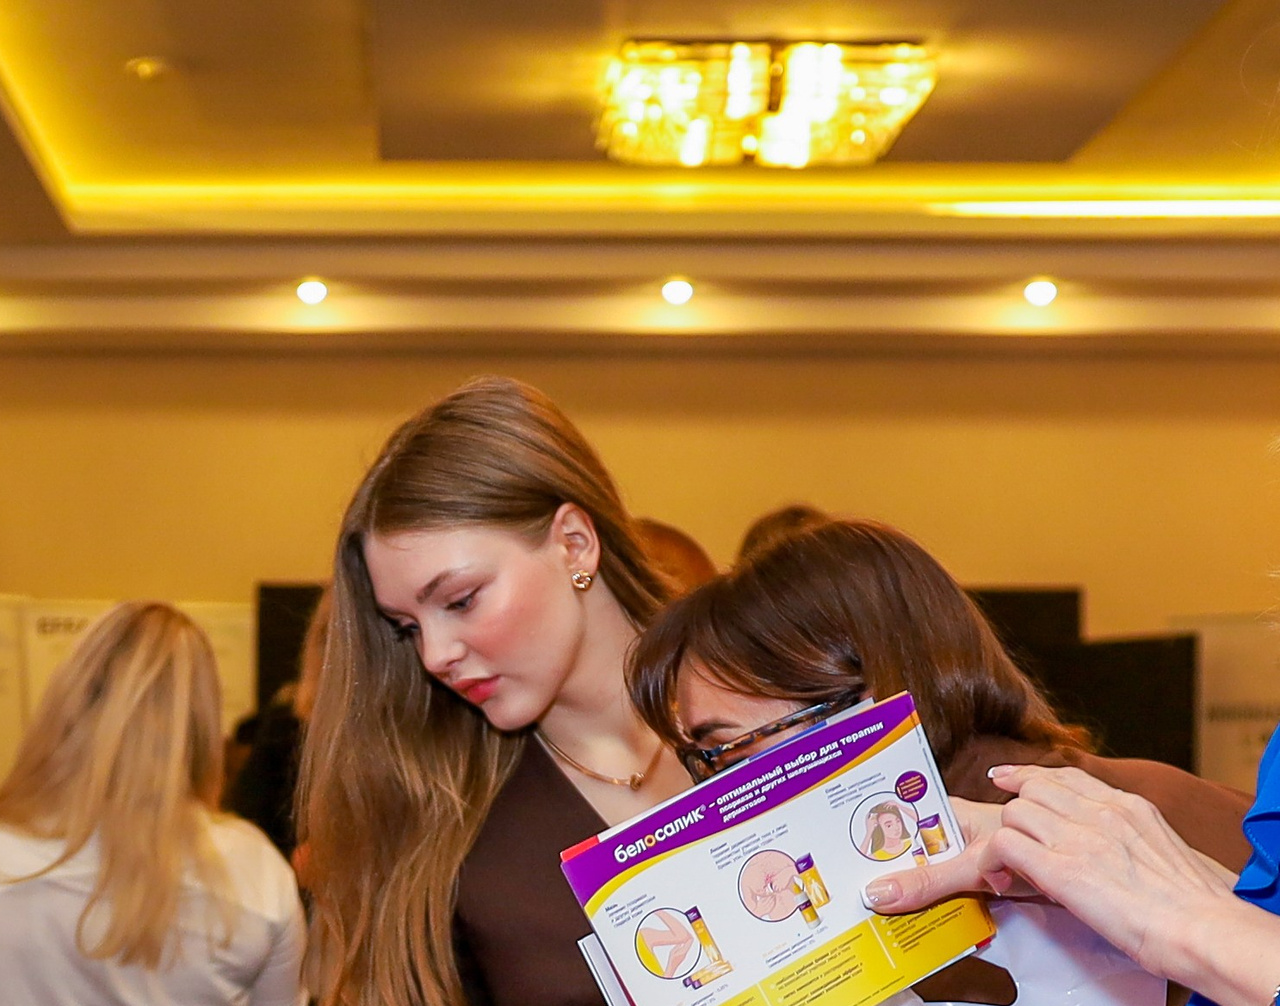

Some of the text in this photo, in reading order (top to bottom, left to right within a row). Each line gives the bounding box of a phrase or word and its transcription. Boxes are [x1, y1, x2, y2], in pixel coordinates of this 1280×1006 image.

[714, 765, 783, 805] оптимальный
[782, 748, 817, 772] выбор
[817, 741, 839, 757] для
[839, 719, 884, 748] терапии
[717, 791, 755, 814] псориаза
[759, 775, 787, 793] других
[720, 794, 768, 822] дерматозов
